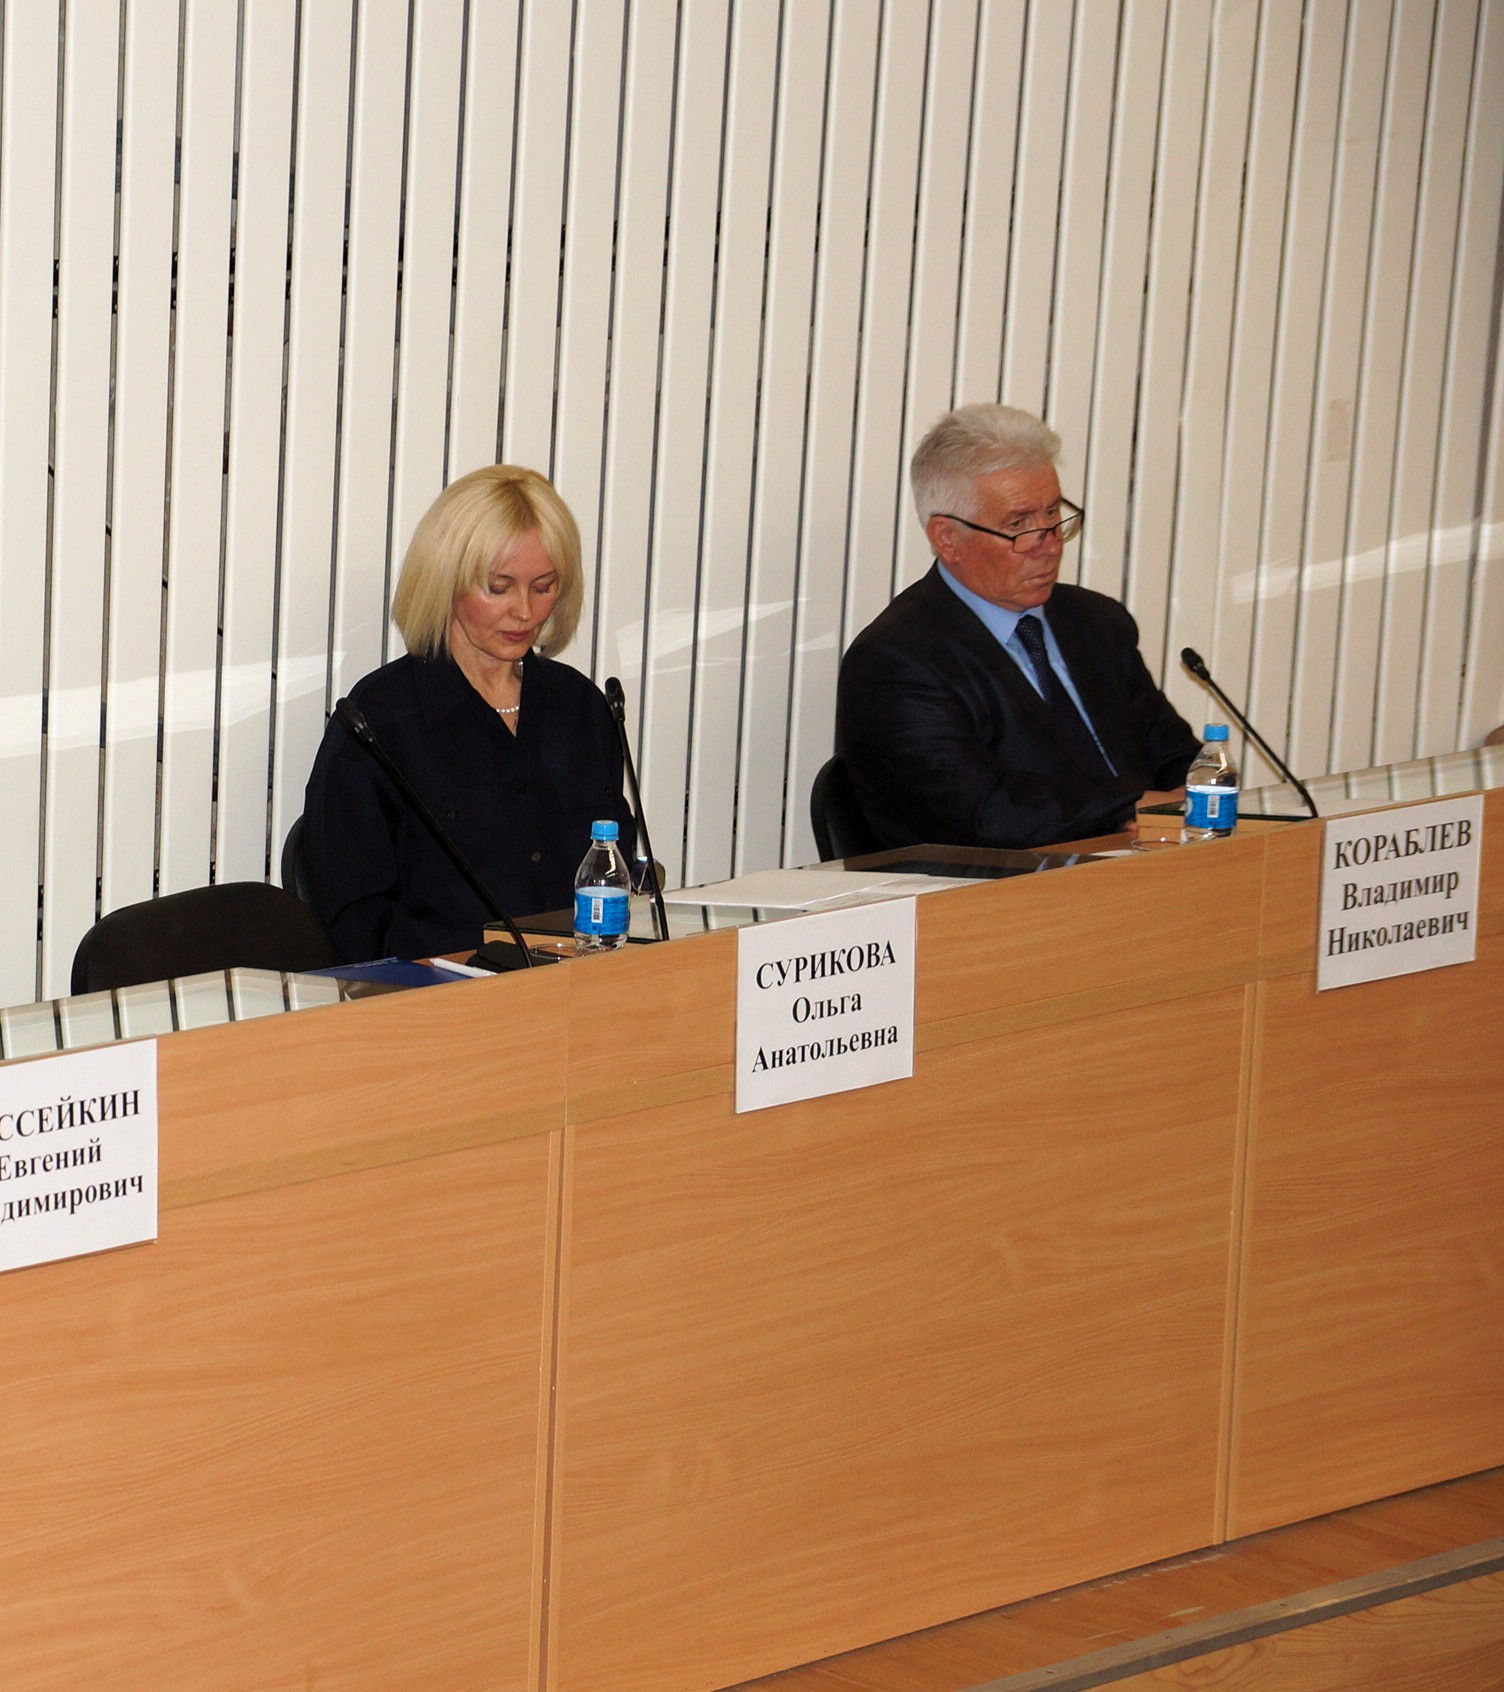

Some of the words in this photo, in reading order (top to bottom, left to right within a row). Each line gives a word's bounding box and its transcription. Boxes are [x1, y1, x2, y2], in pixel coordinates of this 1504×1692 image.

[1334, 819, 1472, 870] КОРАБЛЕВ
[1341, 871, 1459, 911] Владимир
[1327, 911, 1469, 957] Николаевич
[756, 939, 897, 990] СУРИКОВА
[792, 993, 862, 1024] Ольга
[751, 1025, 899, 1073] Анатольевна
